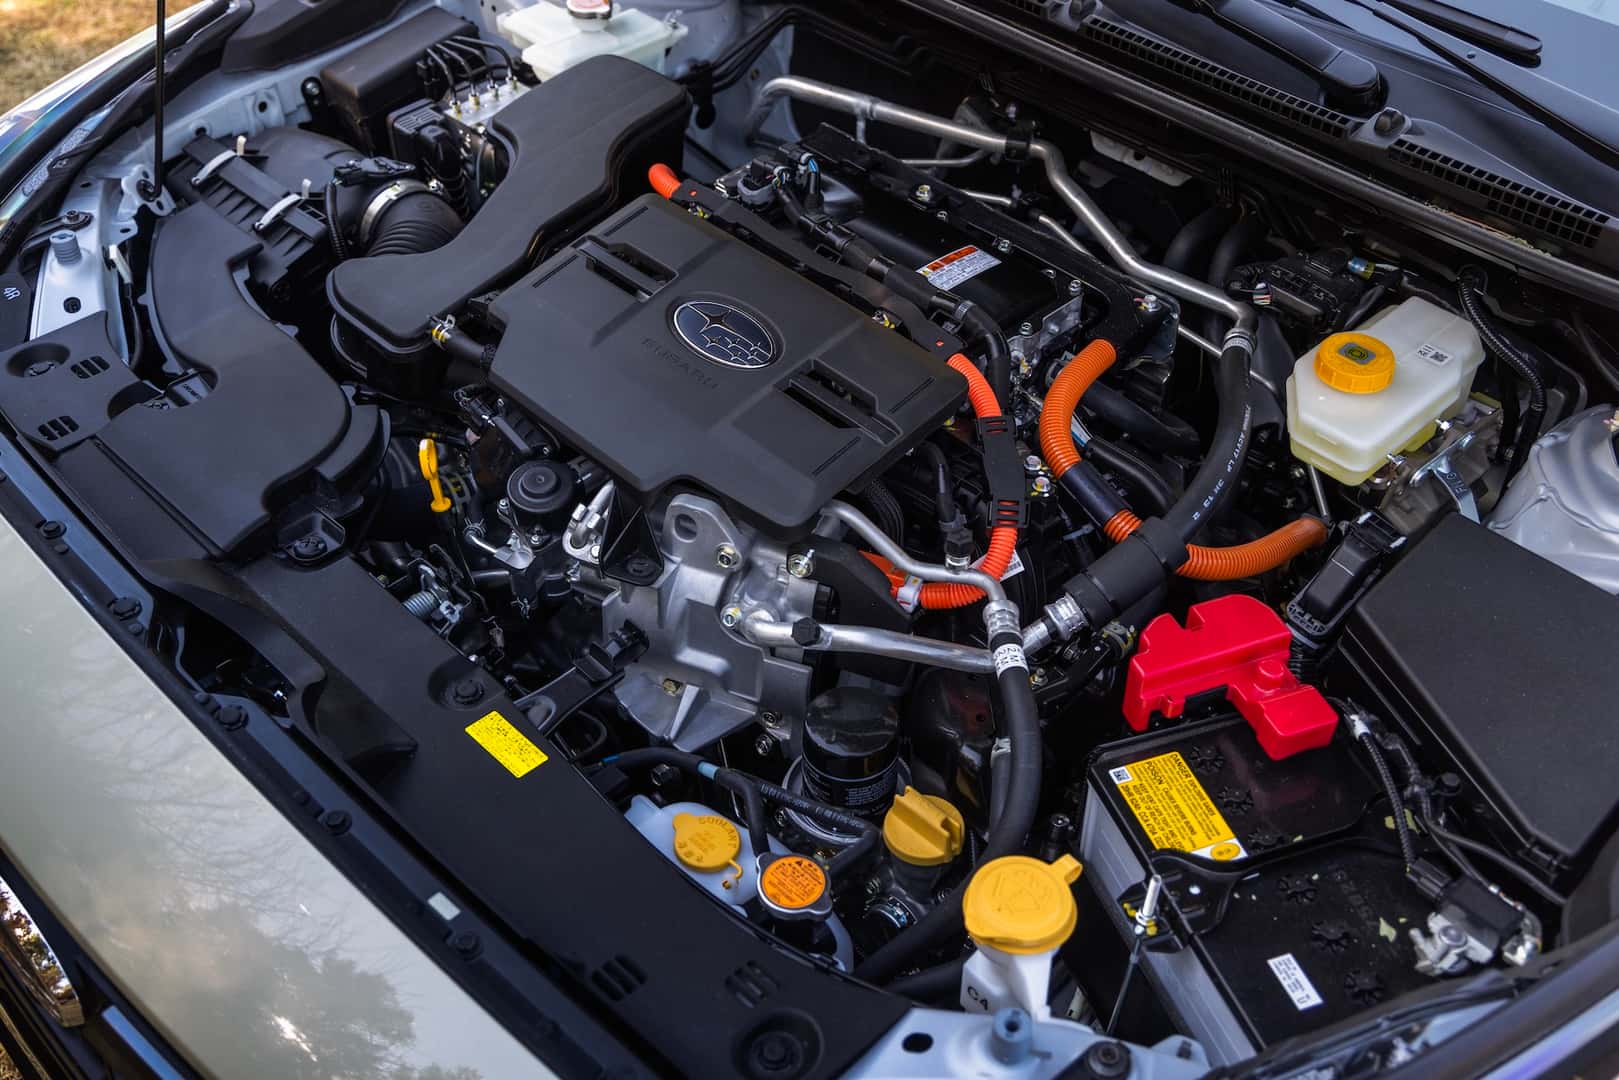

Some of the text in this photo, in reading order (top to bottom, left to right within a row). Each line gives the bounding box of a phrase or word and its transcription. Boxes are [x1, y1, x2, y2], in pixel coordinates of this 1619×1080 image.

[641, 337, 721, 389] SUBARU
[1143, 761, 1165, 785] POISON
[1170, 753, 1191, 778] DANGER
[698, 816, 737, 848] COOLANT
